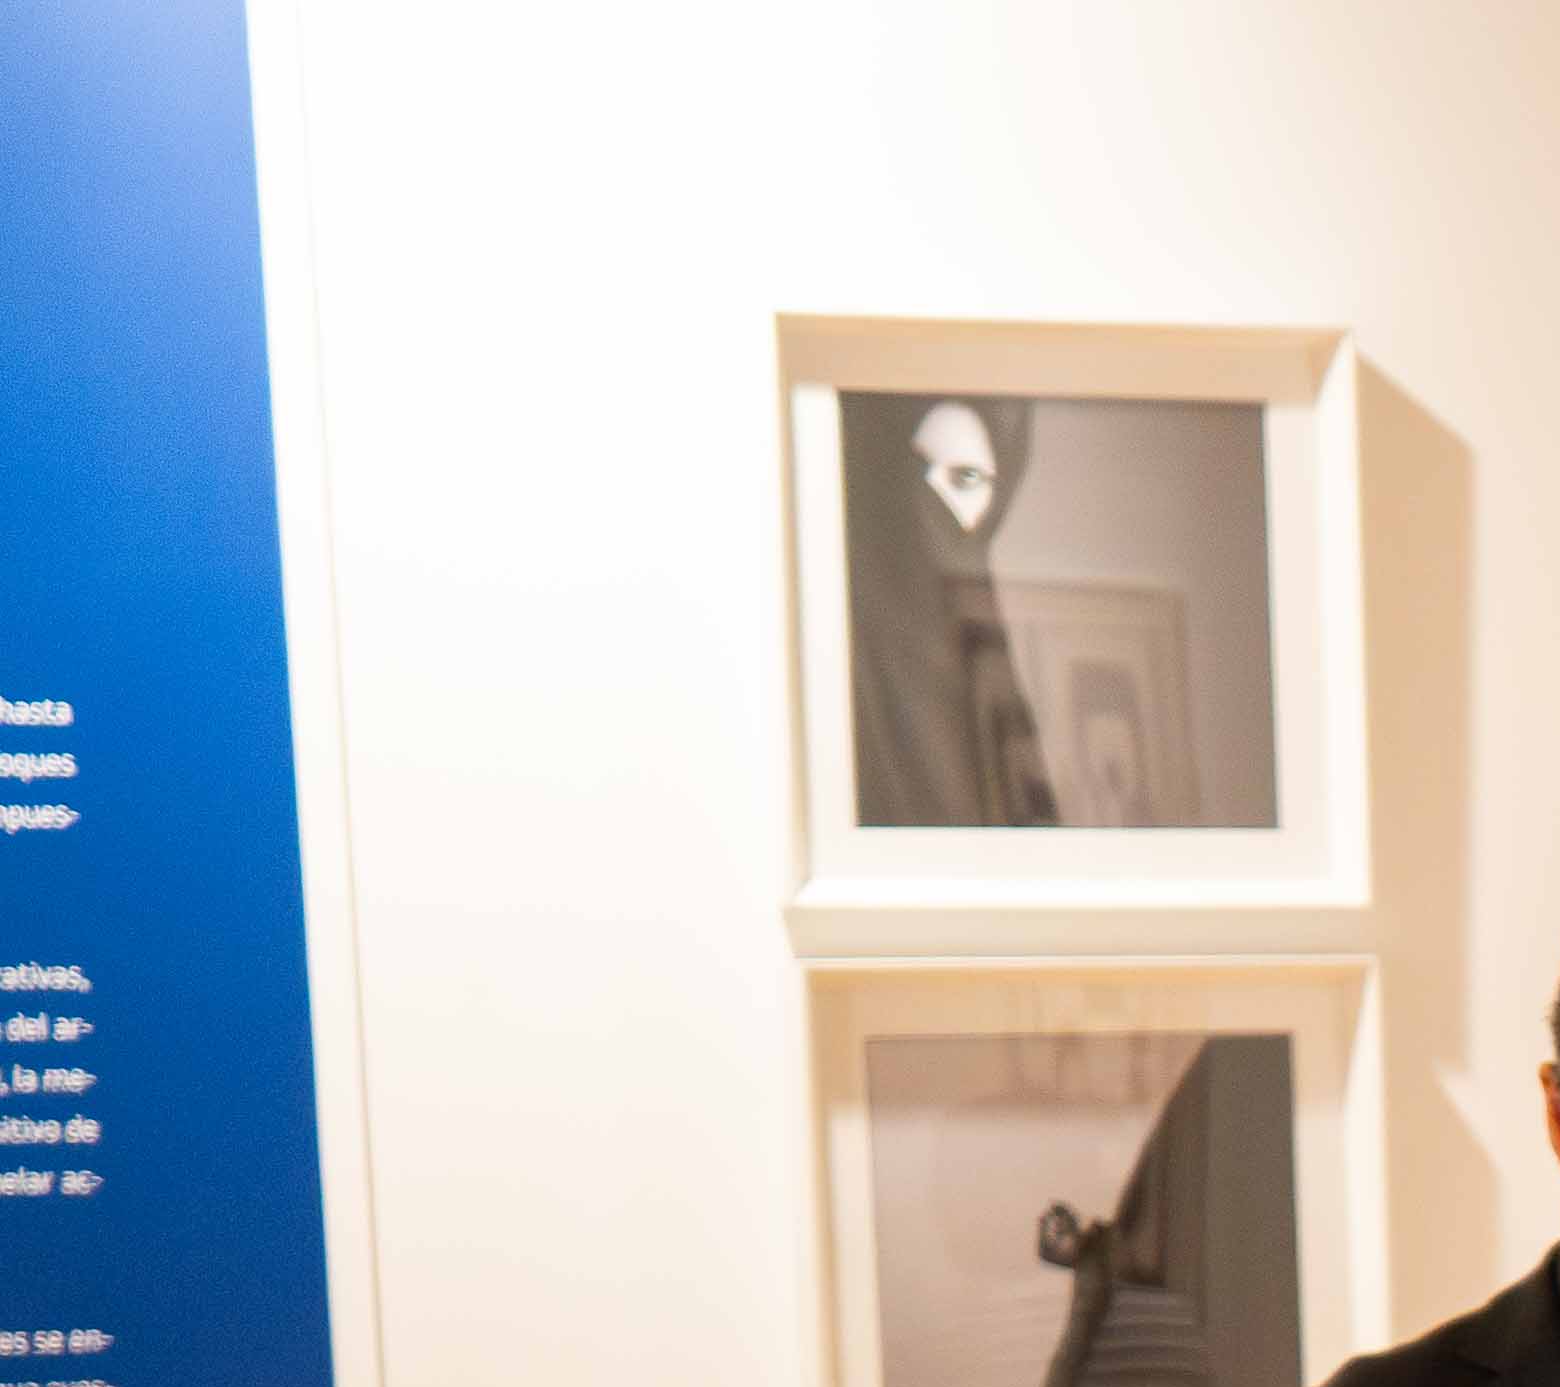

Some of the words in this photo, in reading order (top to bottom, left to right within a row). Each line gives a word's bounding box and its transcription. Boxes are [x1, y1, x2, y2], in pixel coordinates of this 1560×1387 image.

[6, 1013, 50, 1043] del
[11, 1065, 39, 1094] la
[62, 1115, 102, 1144] de
[34, 1331, 66, 1355] se
